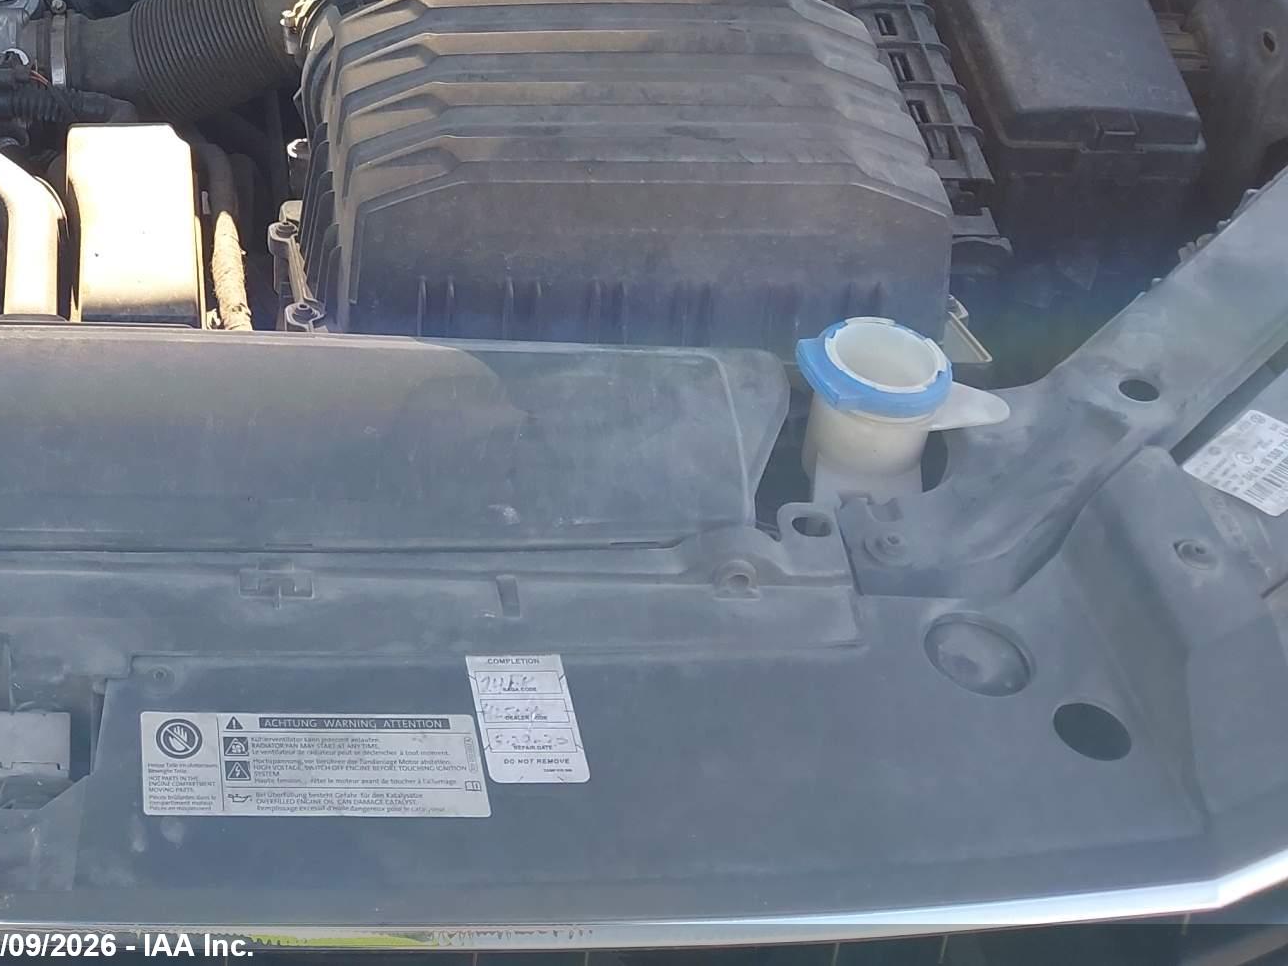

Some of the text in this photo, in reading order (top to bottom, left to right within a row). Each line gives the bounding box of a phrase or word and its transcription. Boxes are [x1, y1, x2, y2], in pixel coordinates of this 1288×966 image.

[264, 719, 443, 728] ACHTUNG WARNING ATTENTION
